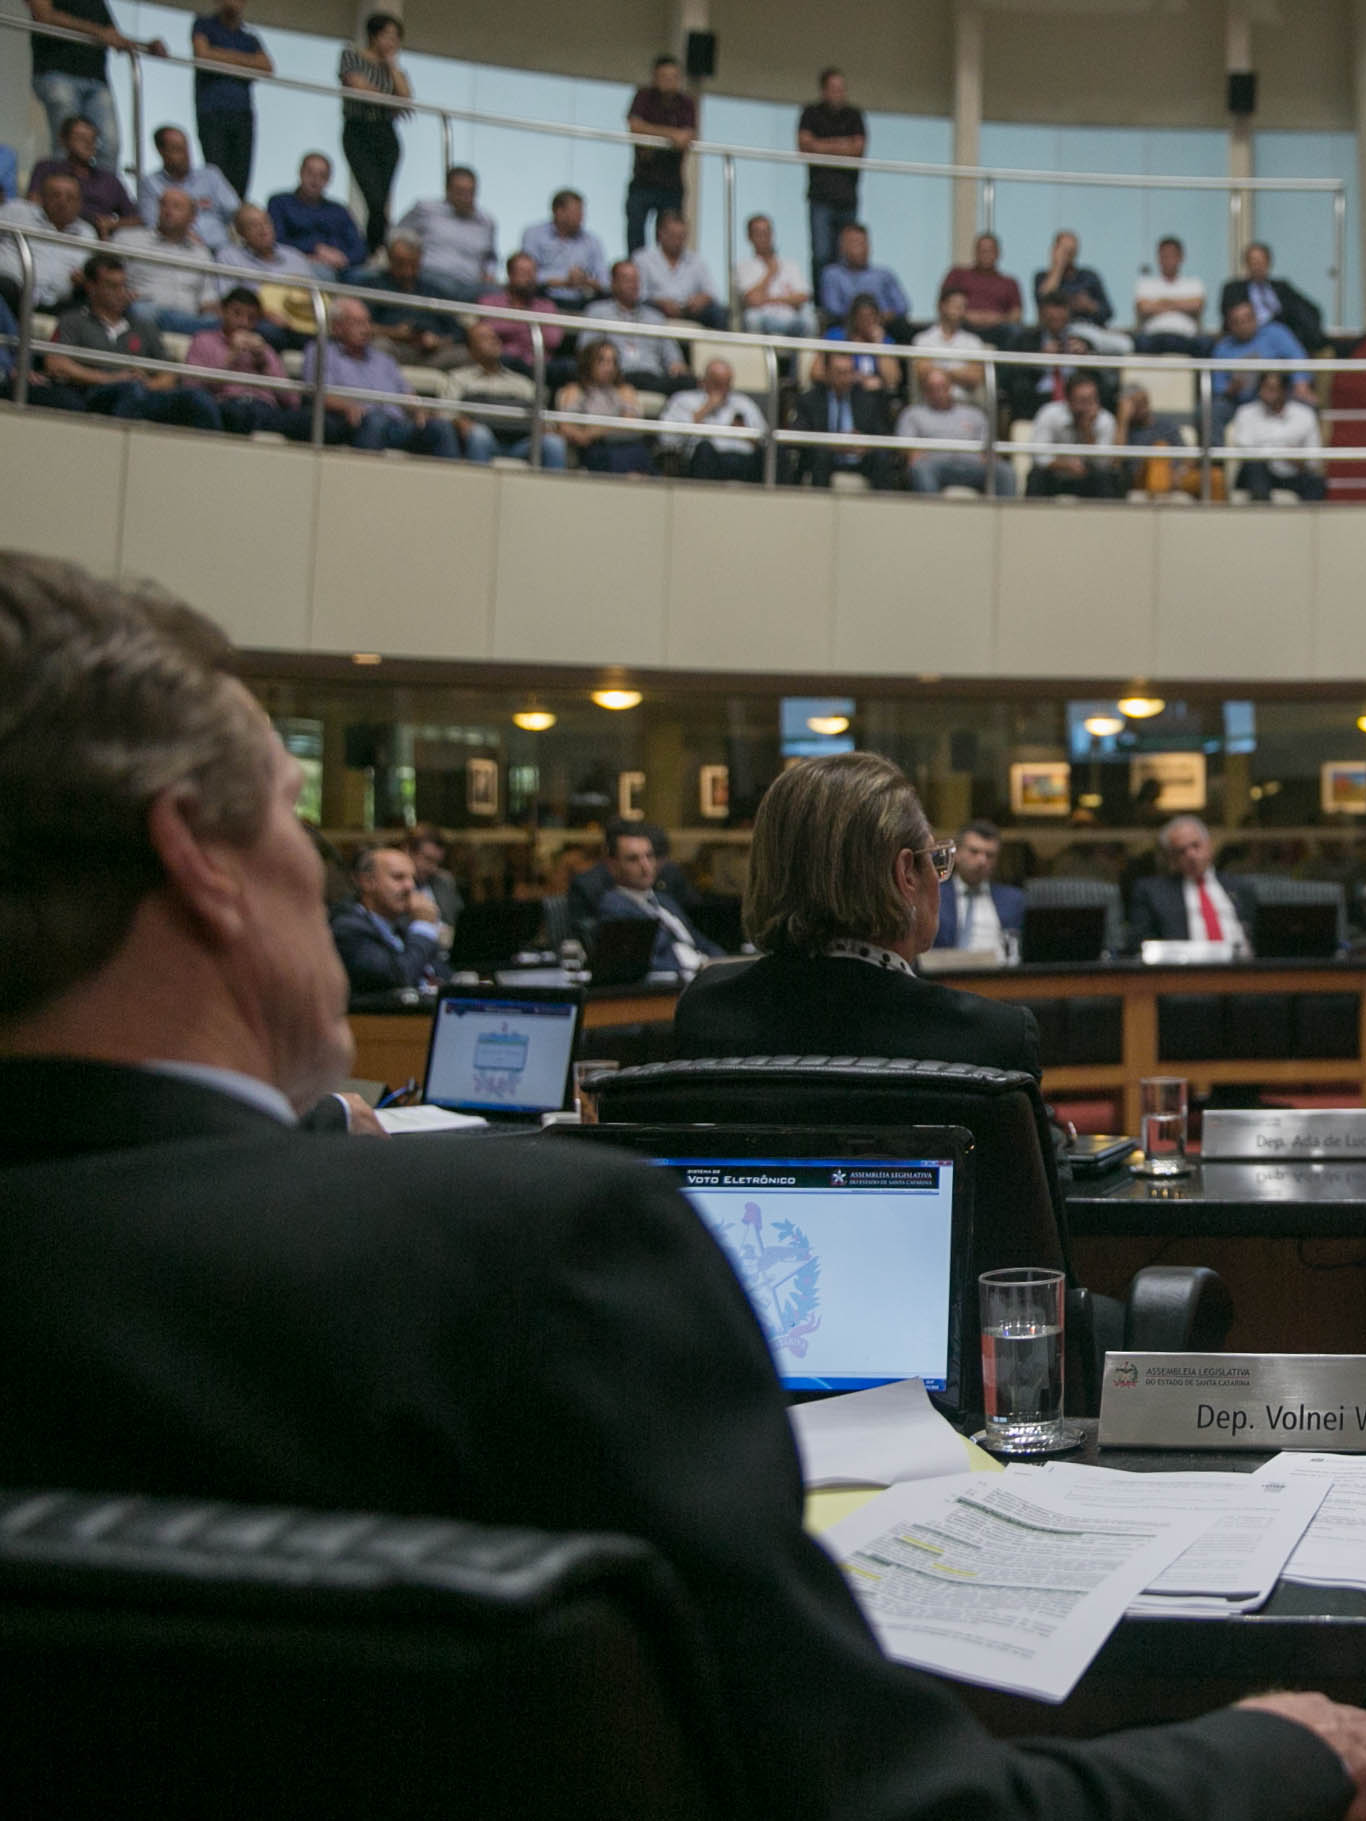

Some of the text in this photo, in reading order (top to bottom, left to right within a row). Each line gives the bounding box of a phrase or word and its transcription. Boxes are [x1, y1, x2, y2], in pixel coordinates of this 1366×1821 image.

[1292, 1133, 1320, 1147] Ada
[1323, 1133, 1342, 1147] de
[687, 1174, 797, 1185] VOTO ELETRÔNICO
[1198, 1367, 1251, 1377] LEGISLATIVA
[1145, 1378, 1251, 1387] DO ESTADO DE SANTA CATARINA
[1196, 1403, 1255, 1436] Dep.
[1265, 1403, 1345, 1431] Volnei
